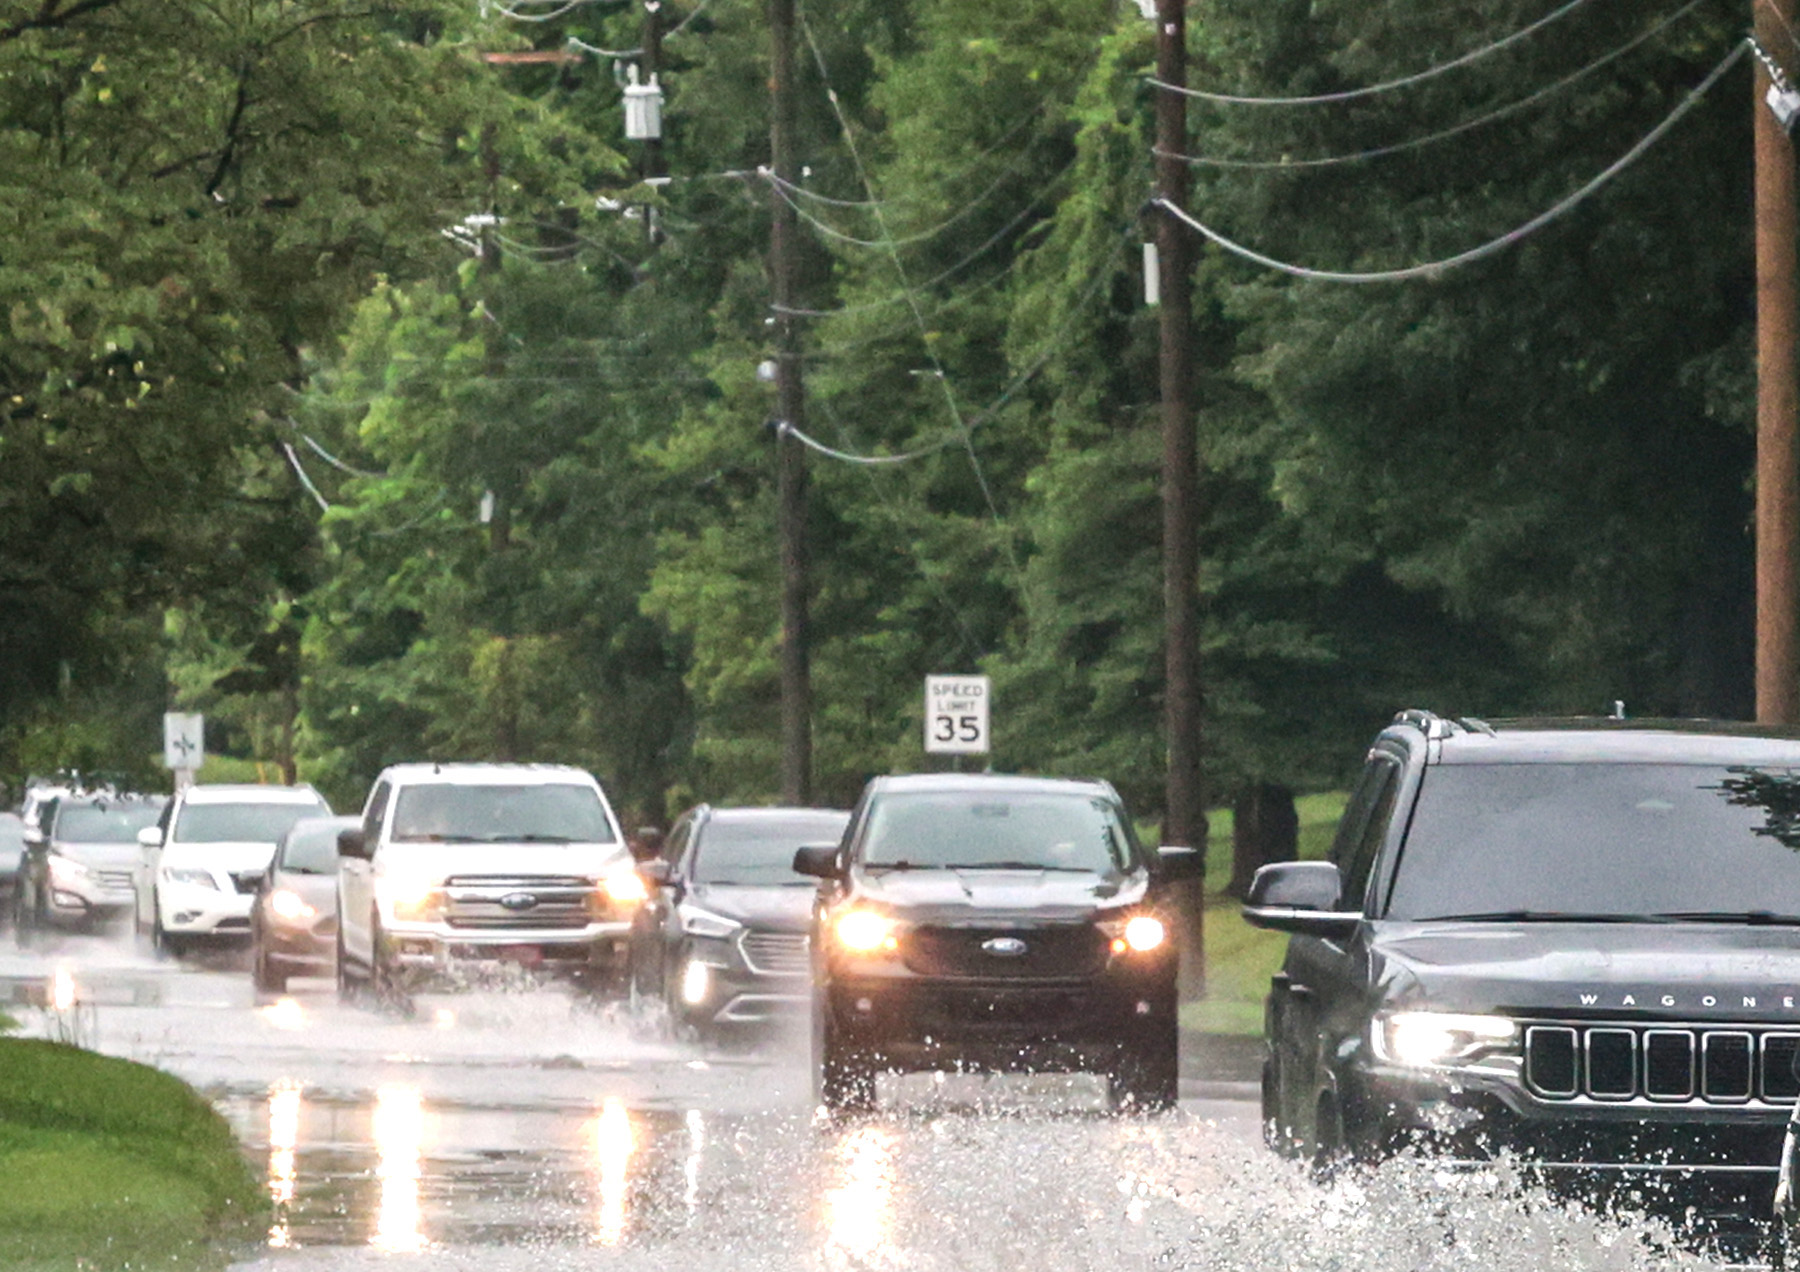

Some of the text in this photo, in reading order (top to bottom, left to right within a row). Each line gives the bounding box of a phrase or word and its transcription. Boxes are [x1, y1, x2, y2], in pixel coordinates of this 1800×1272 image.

[933, 684, 983, 696] SPEED
[937, 701, 975, 712] LIMIT
[935, 715, 979, 742] 35
